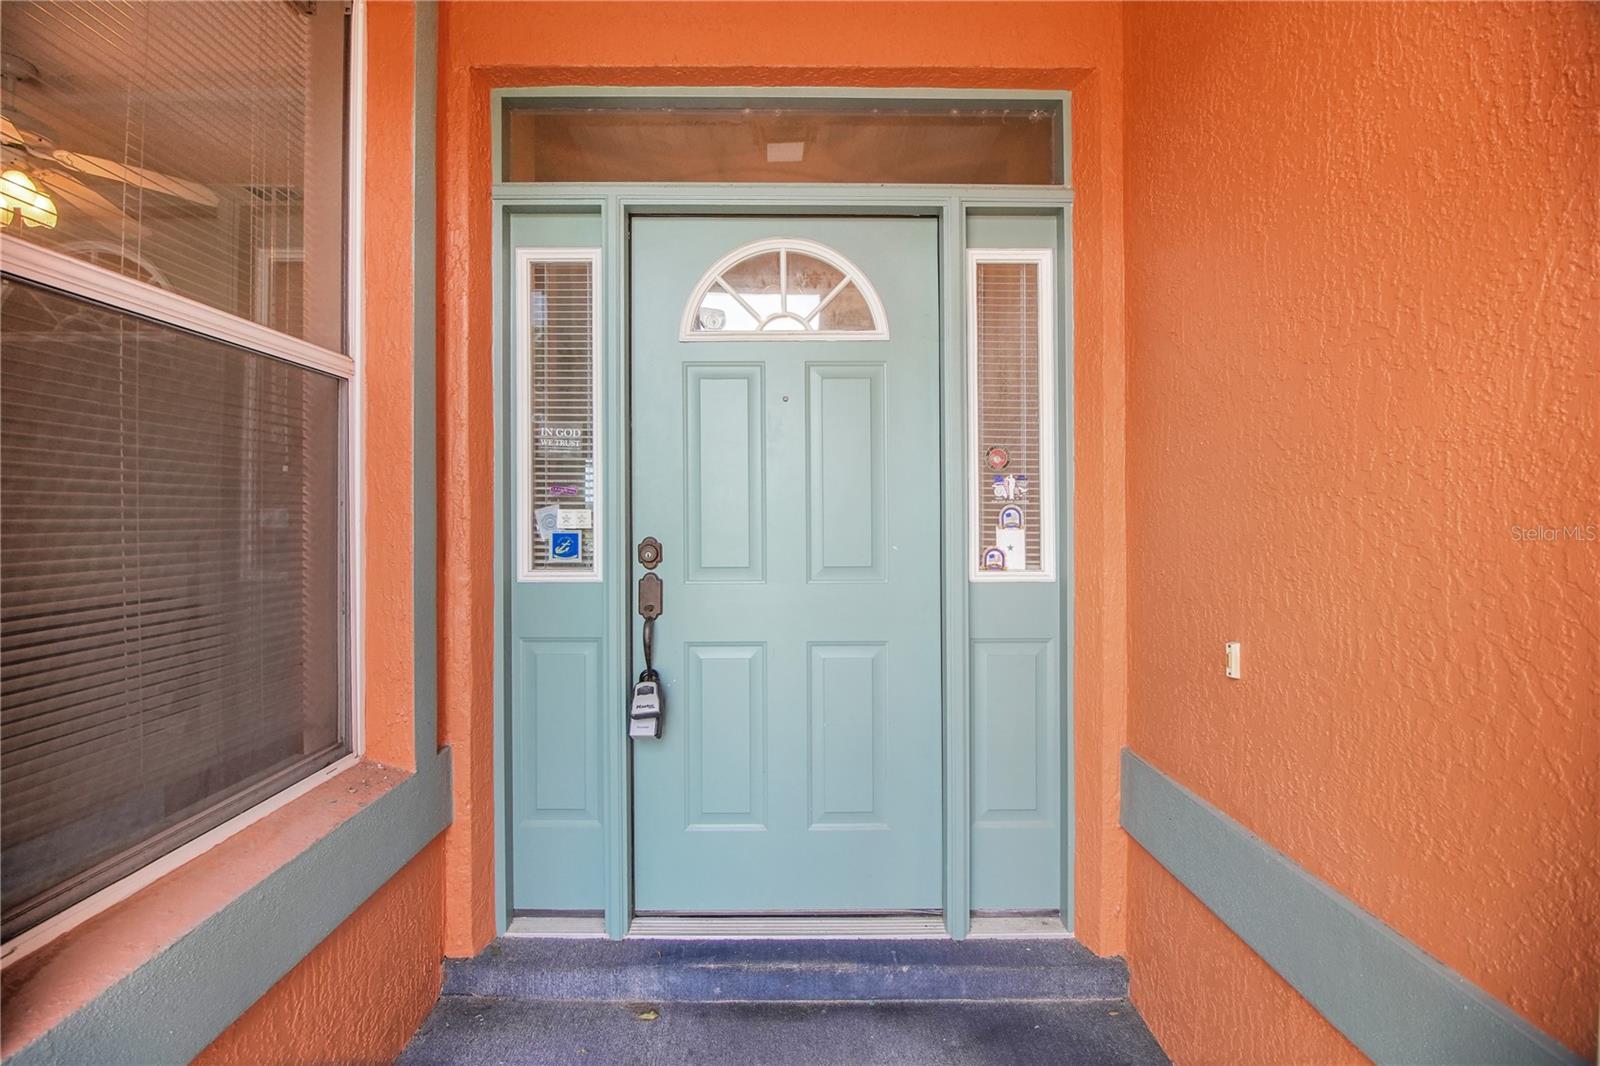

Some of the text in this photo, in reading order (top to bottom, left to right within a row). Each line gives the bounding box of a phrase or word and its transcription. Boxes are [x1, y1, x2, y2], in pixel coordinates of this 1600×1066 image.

[541, 427, 581, 438] IN GOD
[540, 438, 580, 447] WE TRUST
